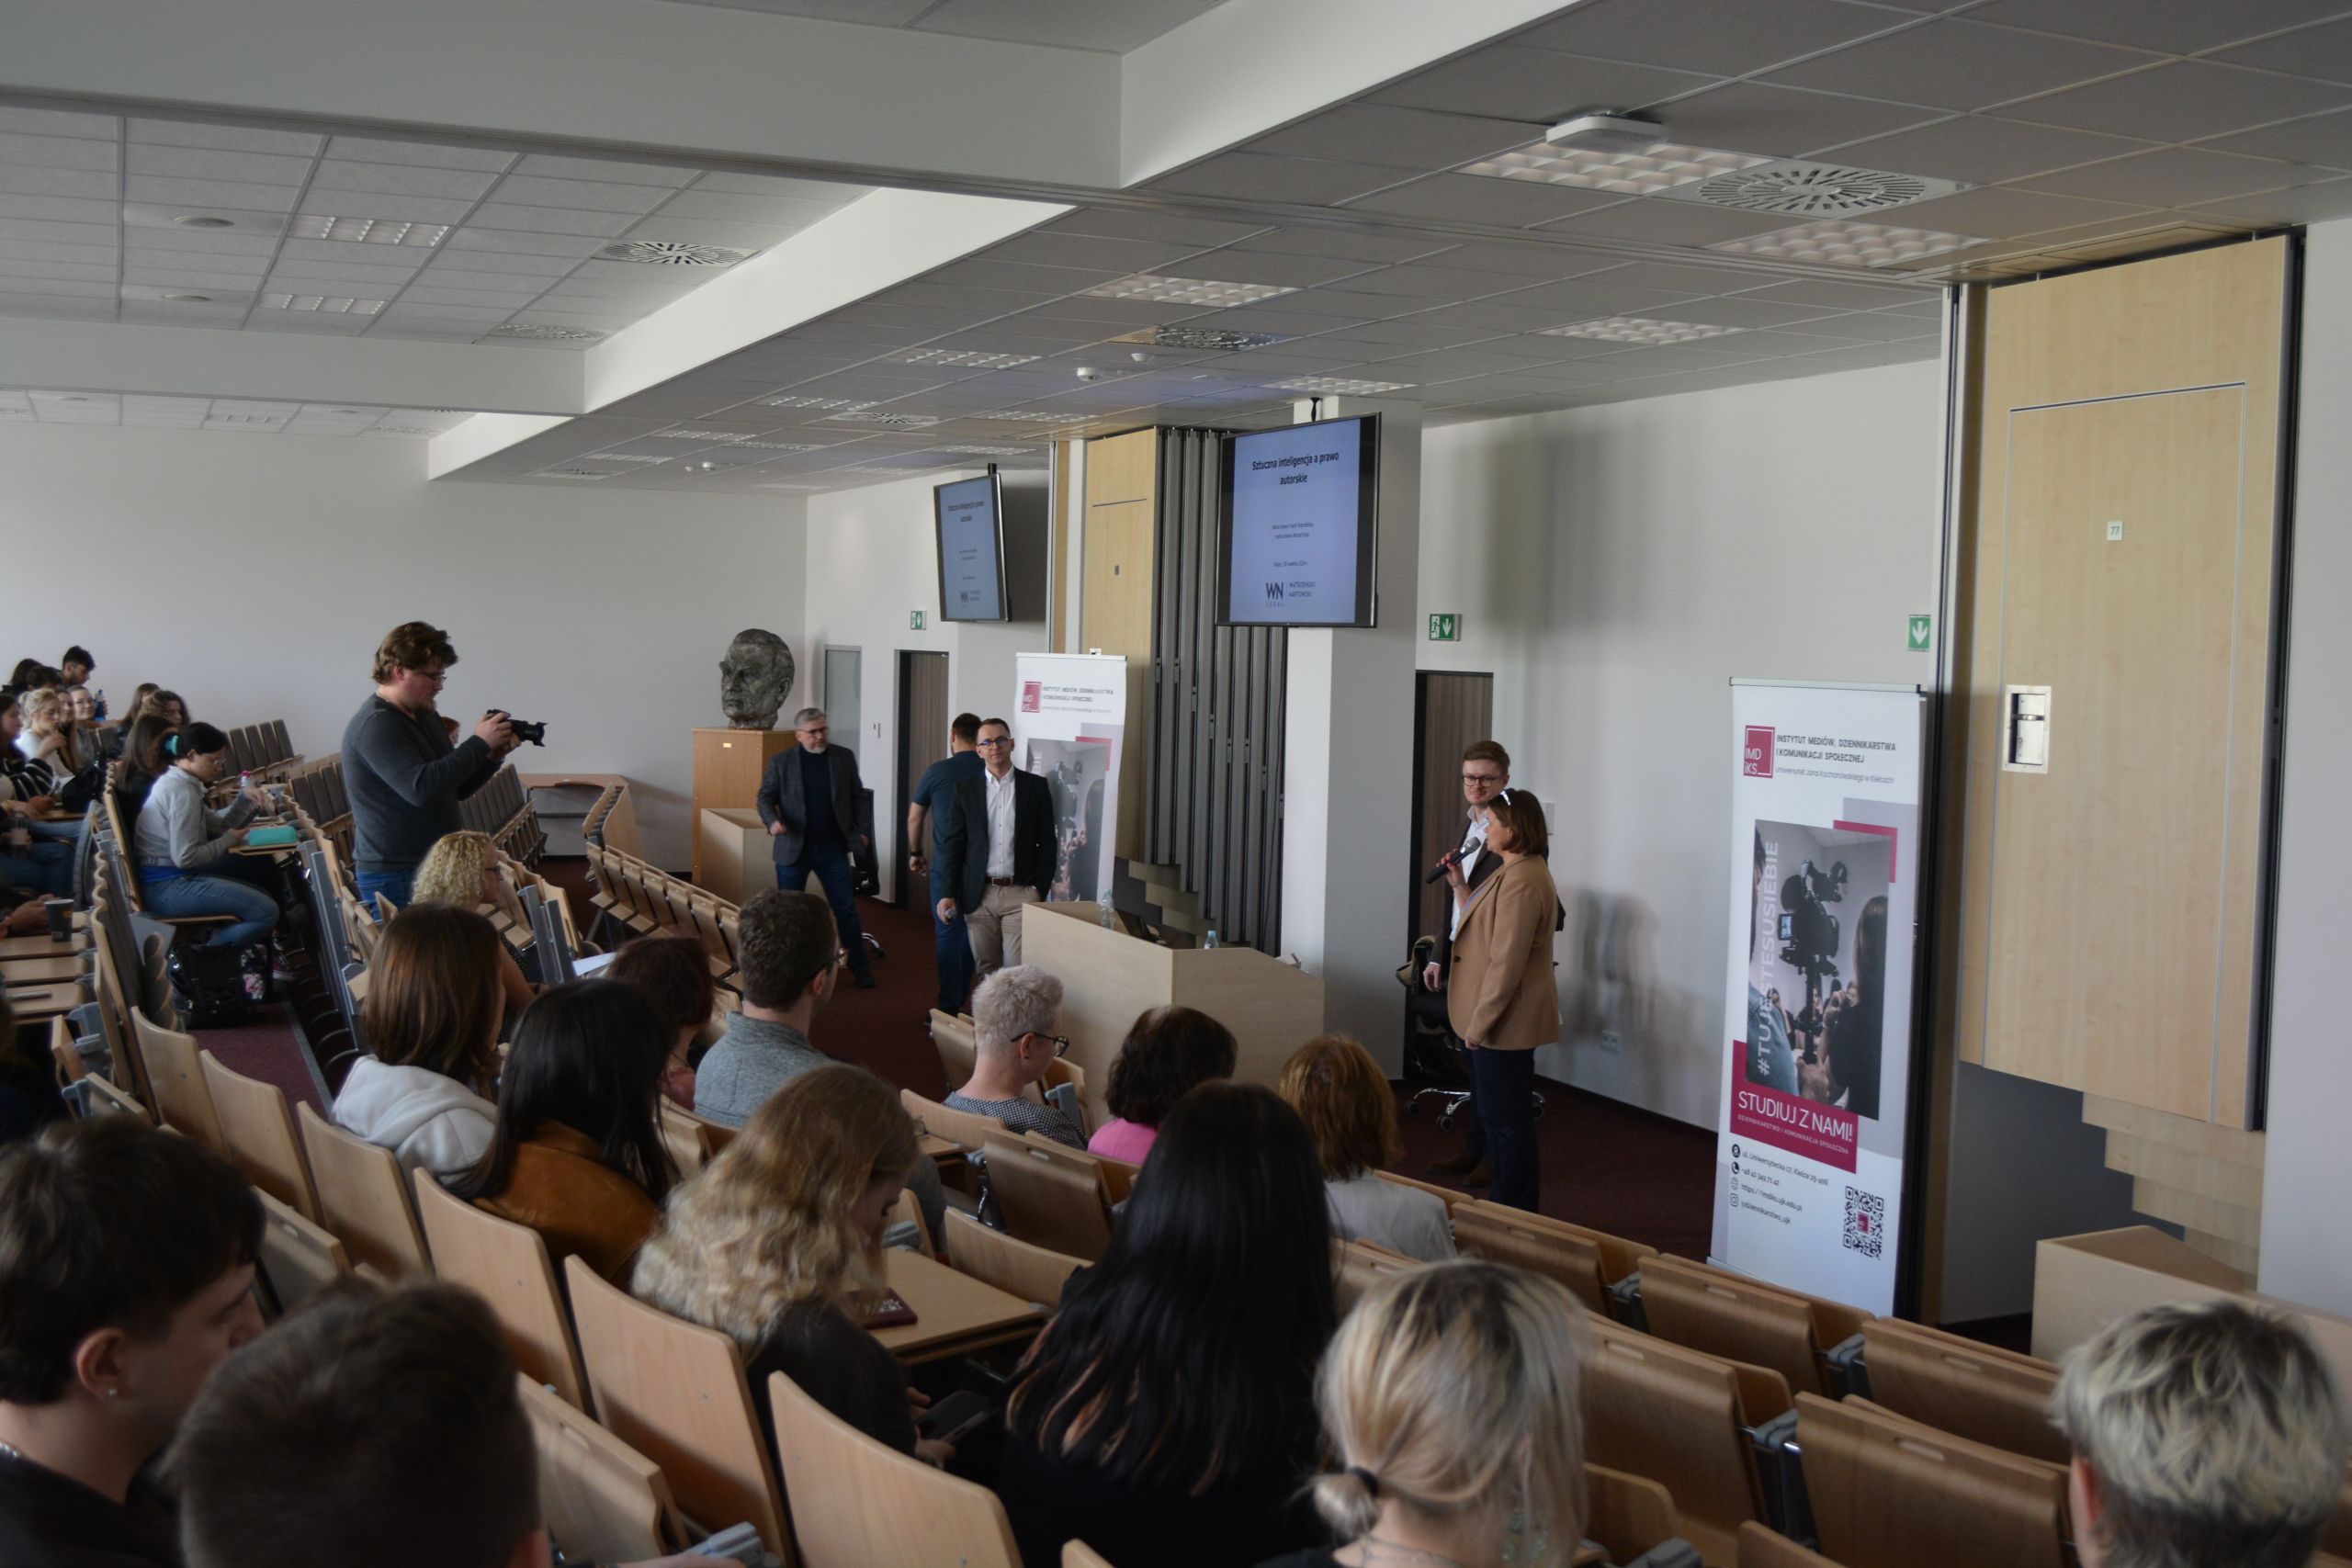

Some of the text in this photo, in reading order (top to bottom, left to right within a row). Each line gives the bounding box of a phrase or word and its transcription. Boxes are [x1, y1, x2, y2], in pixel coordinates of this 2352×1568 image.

[1252, 452, 1340, 470] Sztuczna inteligencja a prawo
[1280, 473, 1307, 485] autorskie
[2110, 525, 2120, 536] 77
[1265, 581, 1283, 600] WN
[1776, 734, 1896, 750] INSTYTUT MEDIÓW, DZIENNIKARSTWA
[1745, 747, 1761, 761] IMD
[1779, 749, 1823, 760] KOMUNIKACJI
[1825, 752, 1864, 763] SPOŁECZNEJ
[1738, 1090, 1853, 1142] STUDIUJ Z NAMI!
